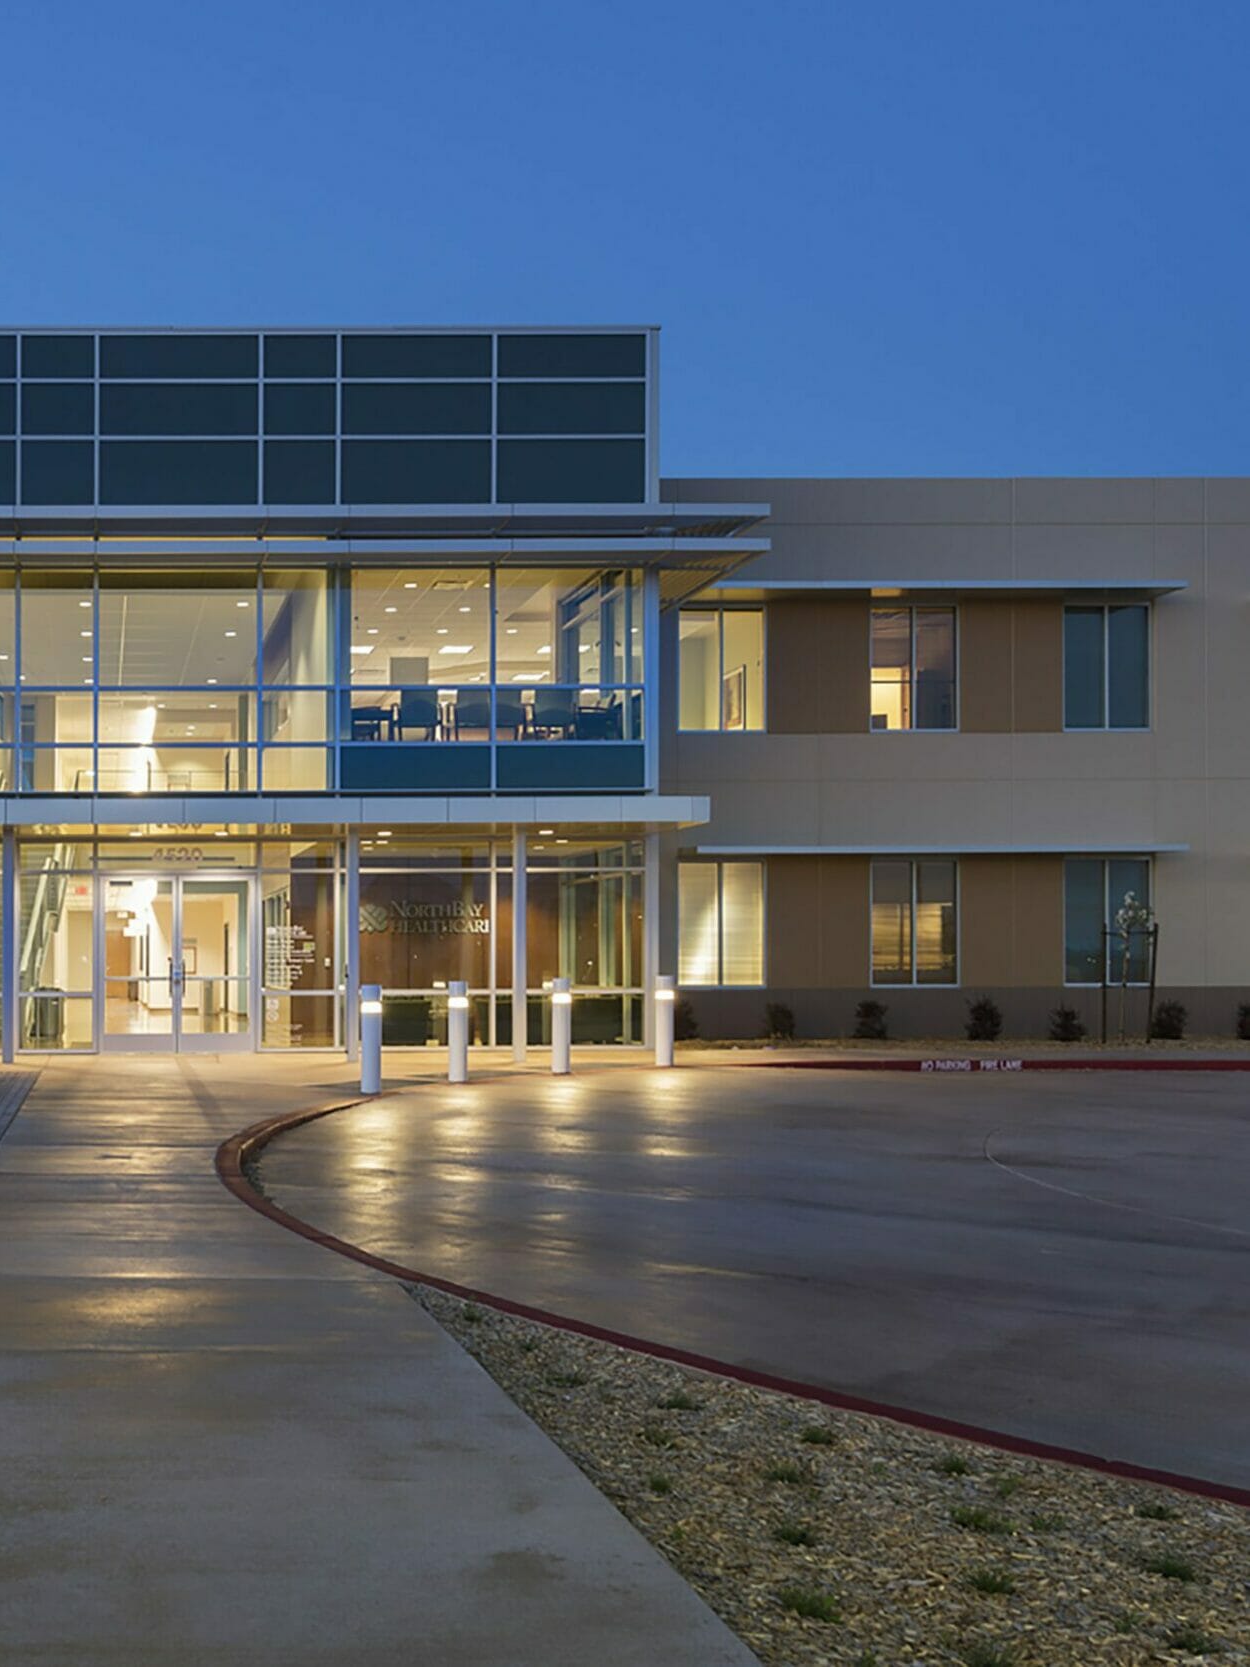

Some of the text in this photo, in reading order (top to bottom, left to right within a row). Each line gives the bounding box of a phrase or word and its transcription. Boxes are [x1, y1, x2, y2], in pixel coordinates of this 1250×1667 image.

[935, 1060, 971, 1071] PARKING
[980, 1060, 998, 1070] FIRE
[1000, 1060, 1023, 1070] LANE
